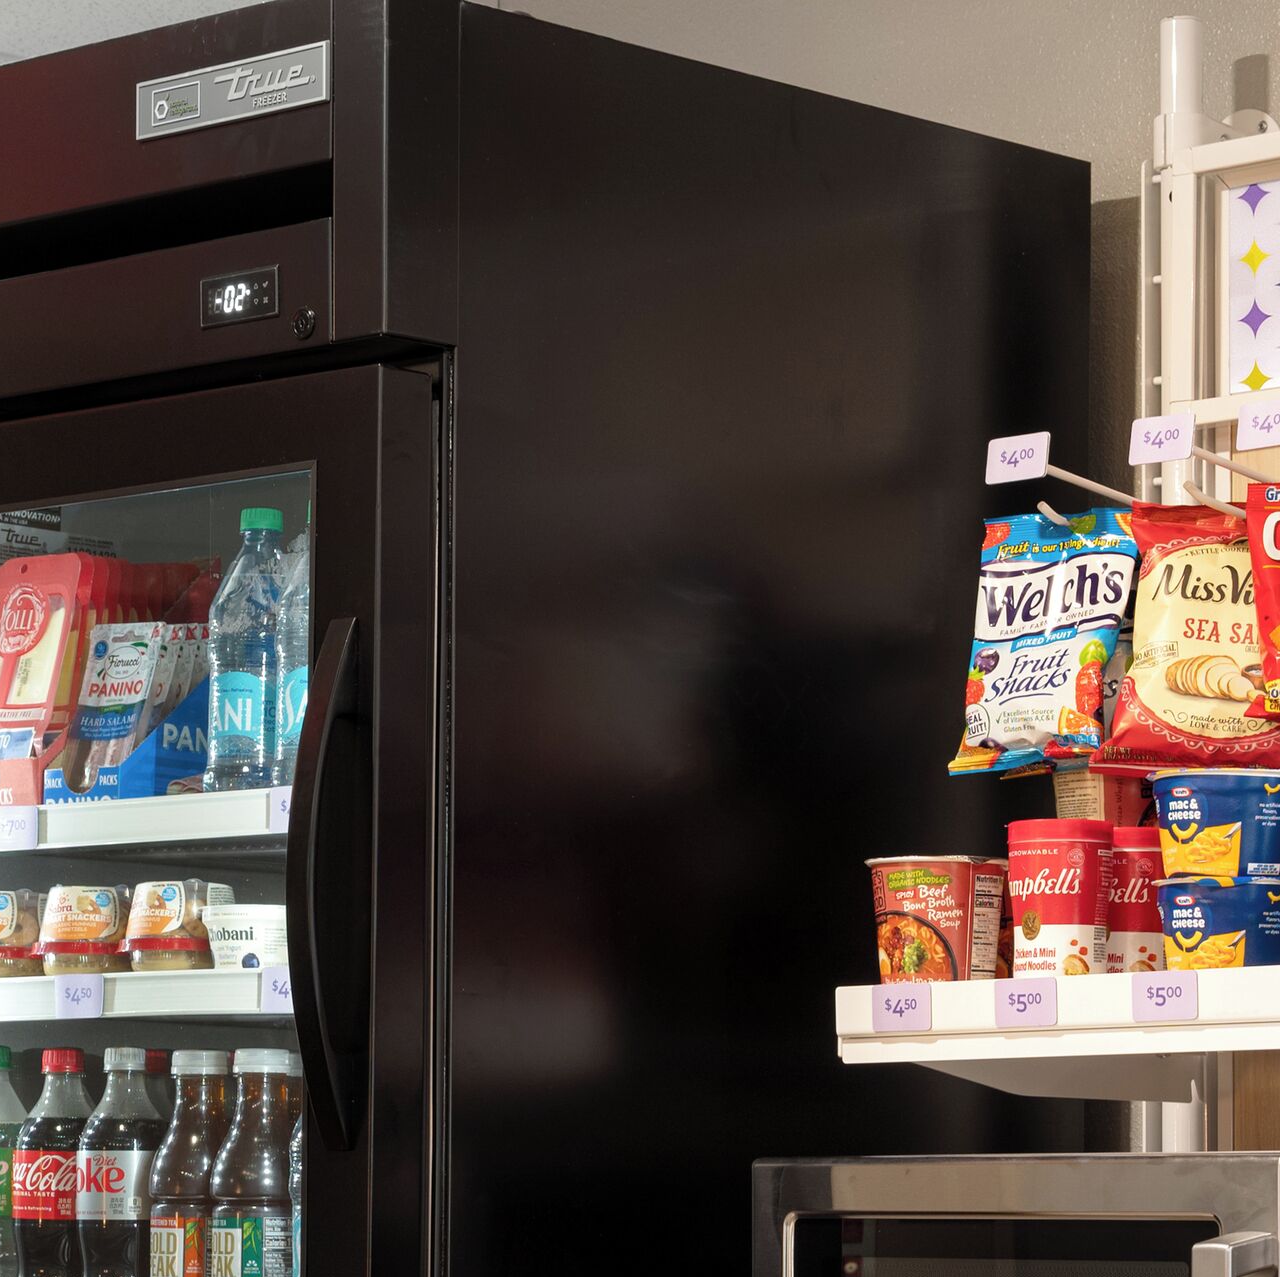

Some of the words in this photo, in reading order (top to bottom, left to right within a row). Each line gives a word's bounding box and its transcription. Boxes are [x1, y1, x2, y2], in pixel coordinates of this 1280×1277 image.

[214, 64, 310, 101] true
[253, 92, 287, 108] FREEZER
[5, 609, 33, 631] OLLI
[1013, 648, 1069, 680] Fruit
[88, 679, 144, 697] PANINO
[985, 667, 1071, 703] Snacks
[1169, 800, 1188, 810] mac
[1190, 799, 1198, 809] &
[919, 885, 948, 899] Beef
[903, 901, 926, 912] Bone
[928, 897, 955, 909] Broth
[927, 909, 963, 921] Ramen
[93, 1155, 116, 1166] Diet
[77, 1158, 125, 1193] oke
